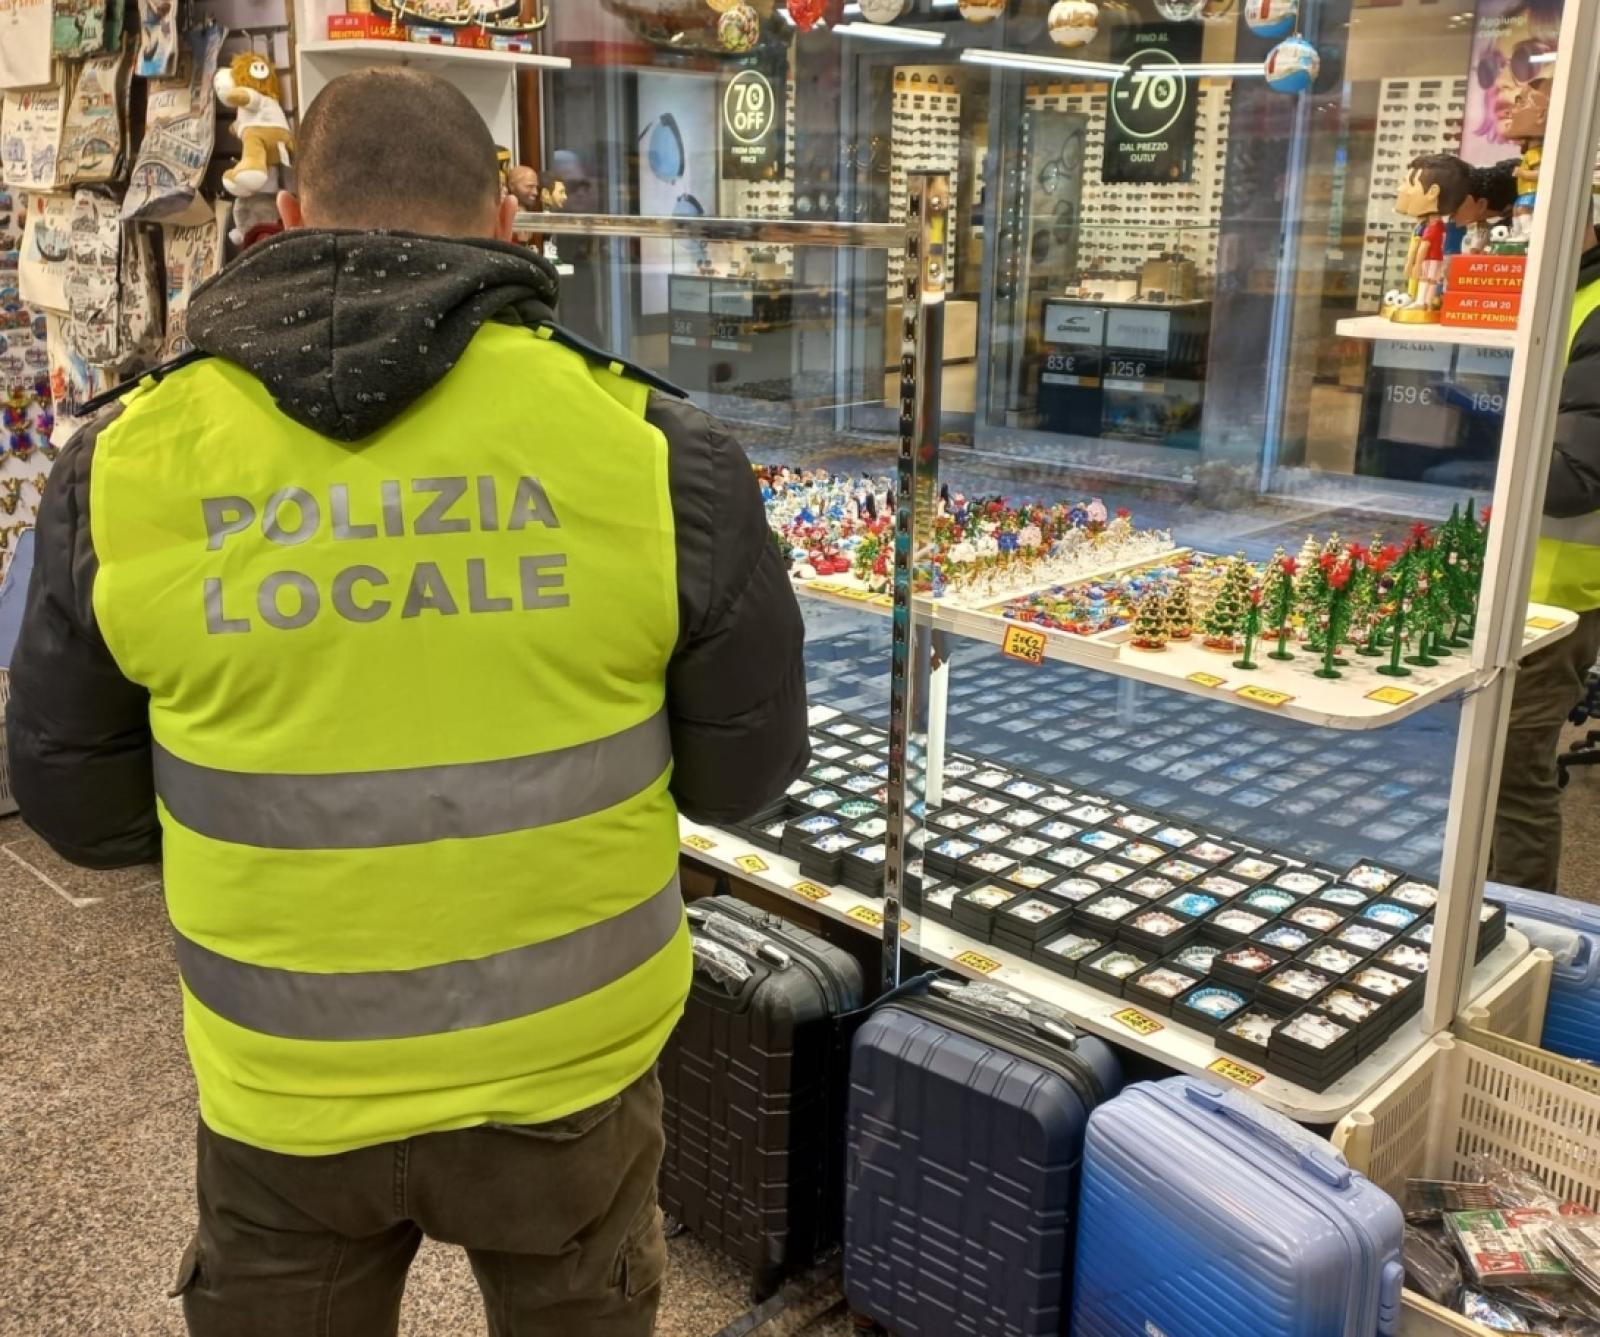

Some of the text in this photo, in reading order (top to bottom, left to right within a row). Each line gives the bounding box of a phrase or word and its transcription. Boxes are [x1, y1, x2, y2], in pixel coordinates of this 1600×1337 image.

[733, 111, 764, 130] OFF
[1119, 141, 1169, 152] DAL PREZZO
[1469, 263, 1489, 273] ART
[1492, 264, 1509, 274] GM
[1458, 276, 1523, 288] BREVETTAT
[1459, 299, 1512, 311] ART GM 20
[1445, 311, 1479, 321] PATENT
[200, 475, 562, 552] POLIZIA
[203, 553, 570, 635] LOCALE
